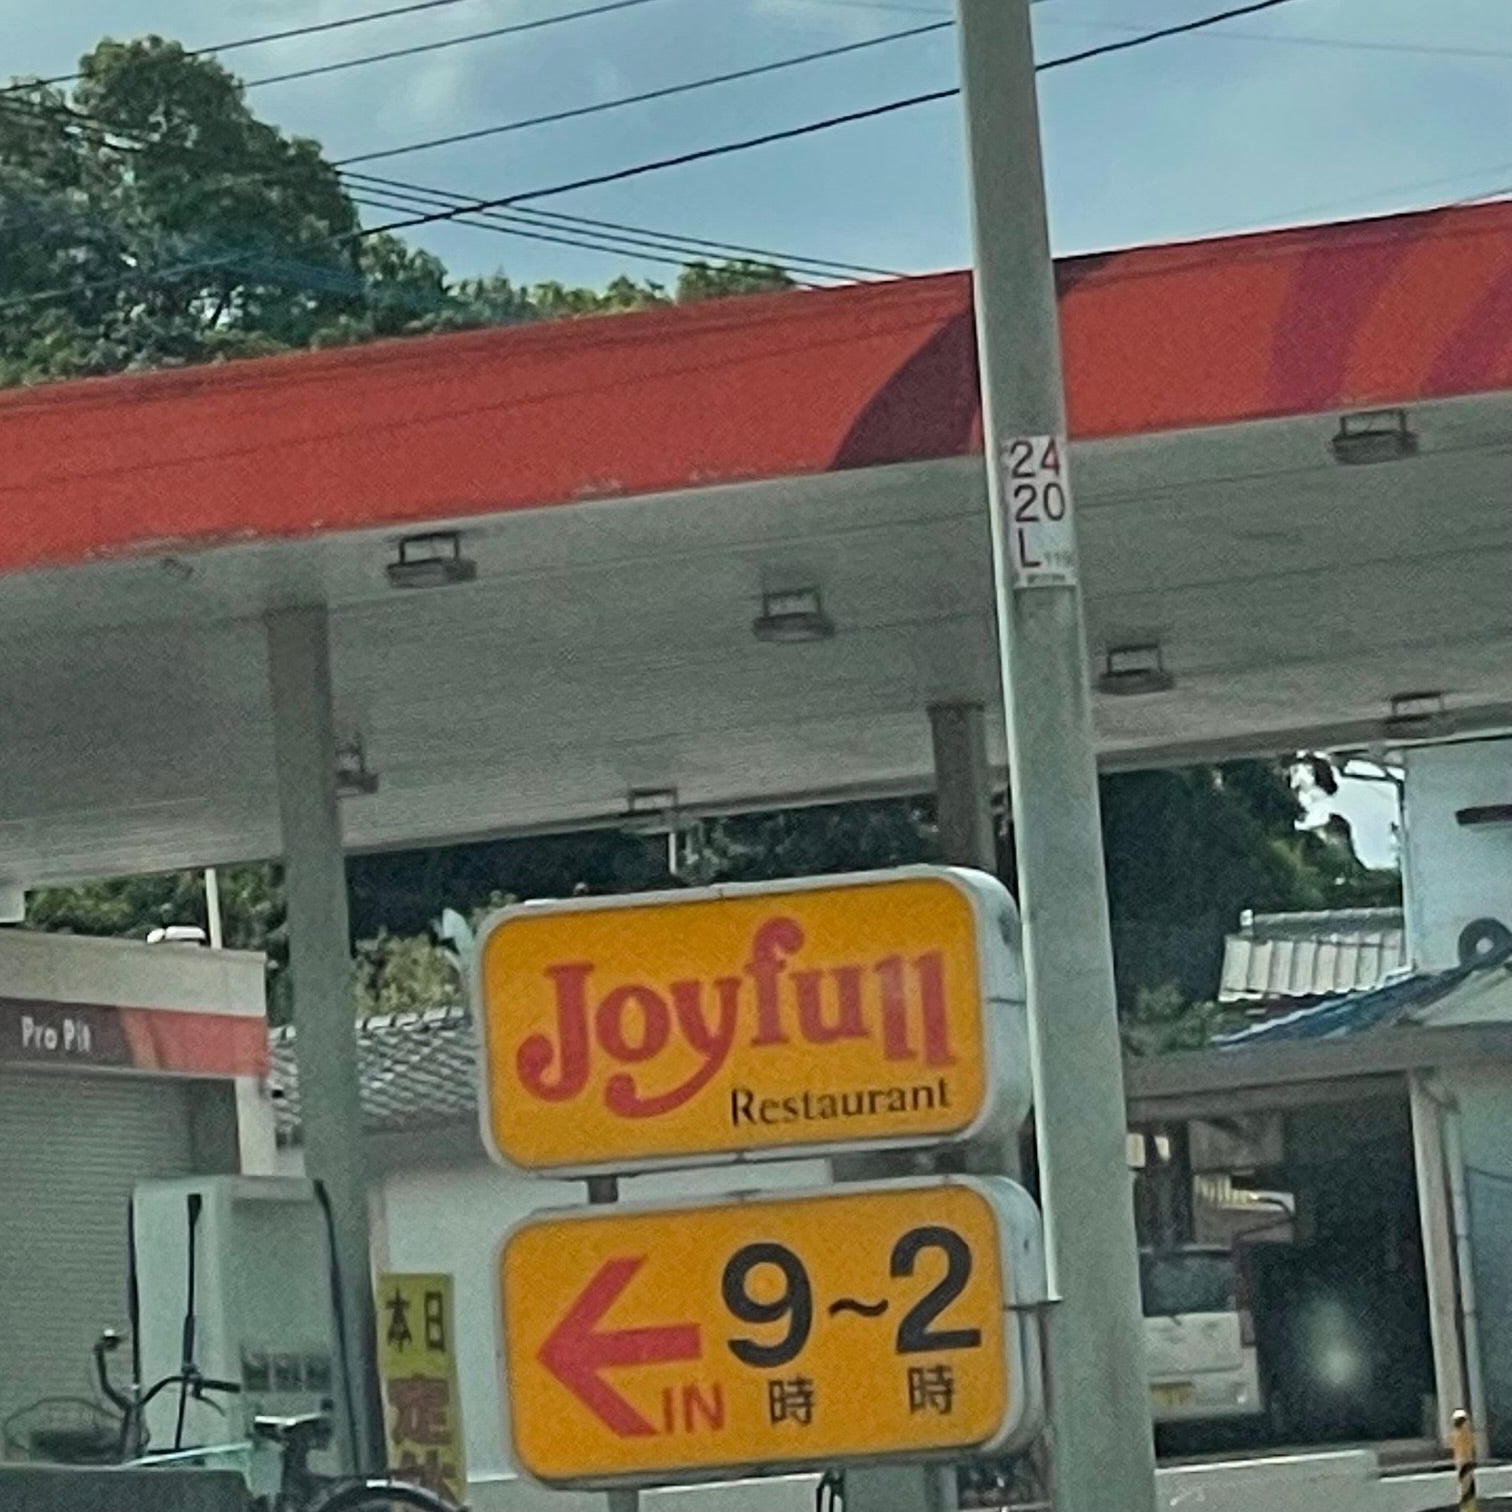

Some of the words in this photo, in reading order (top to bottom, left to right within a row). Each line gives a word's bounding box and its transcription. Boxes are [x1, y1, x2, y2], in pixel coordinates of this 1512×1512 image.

[1009, 438, 1061, 478] 24
[1014, 482, 1066, 522] 20
[1018, 527, 1042, 568] L
[21, 1015, 58, 1051] Pro
[515, 916, 958, 1120] Joyfull
[731, 1077, 951, 1127] Restaurant
[662, 1381, 726, 1434] IN
[768, 1375, 814, 1426] 時
[907, 1364, 954, 1416] 時
